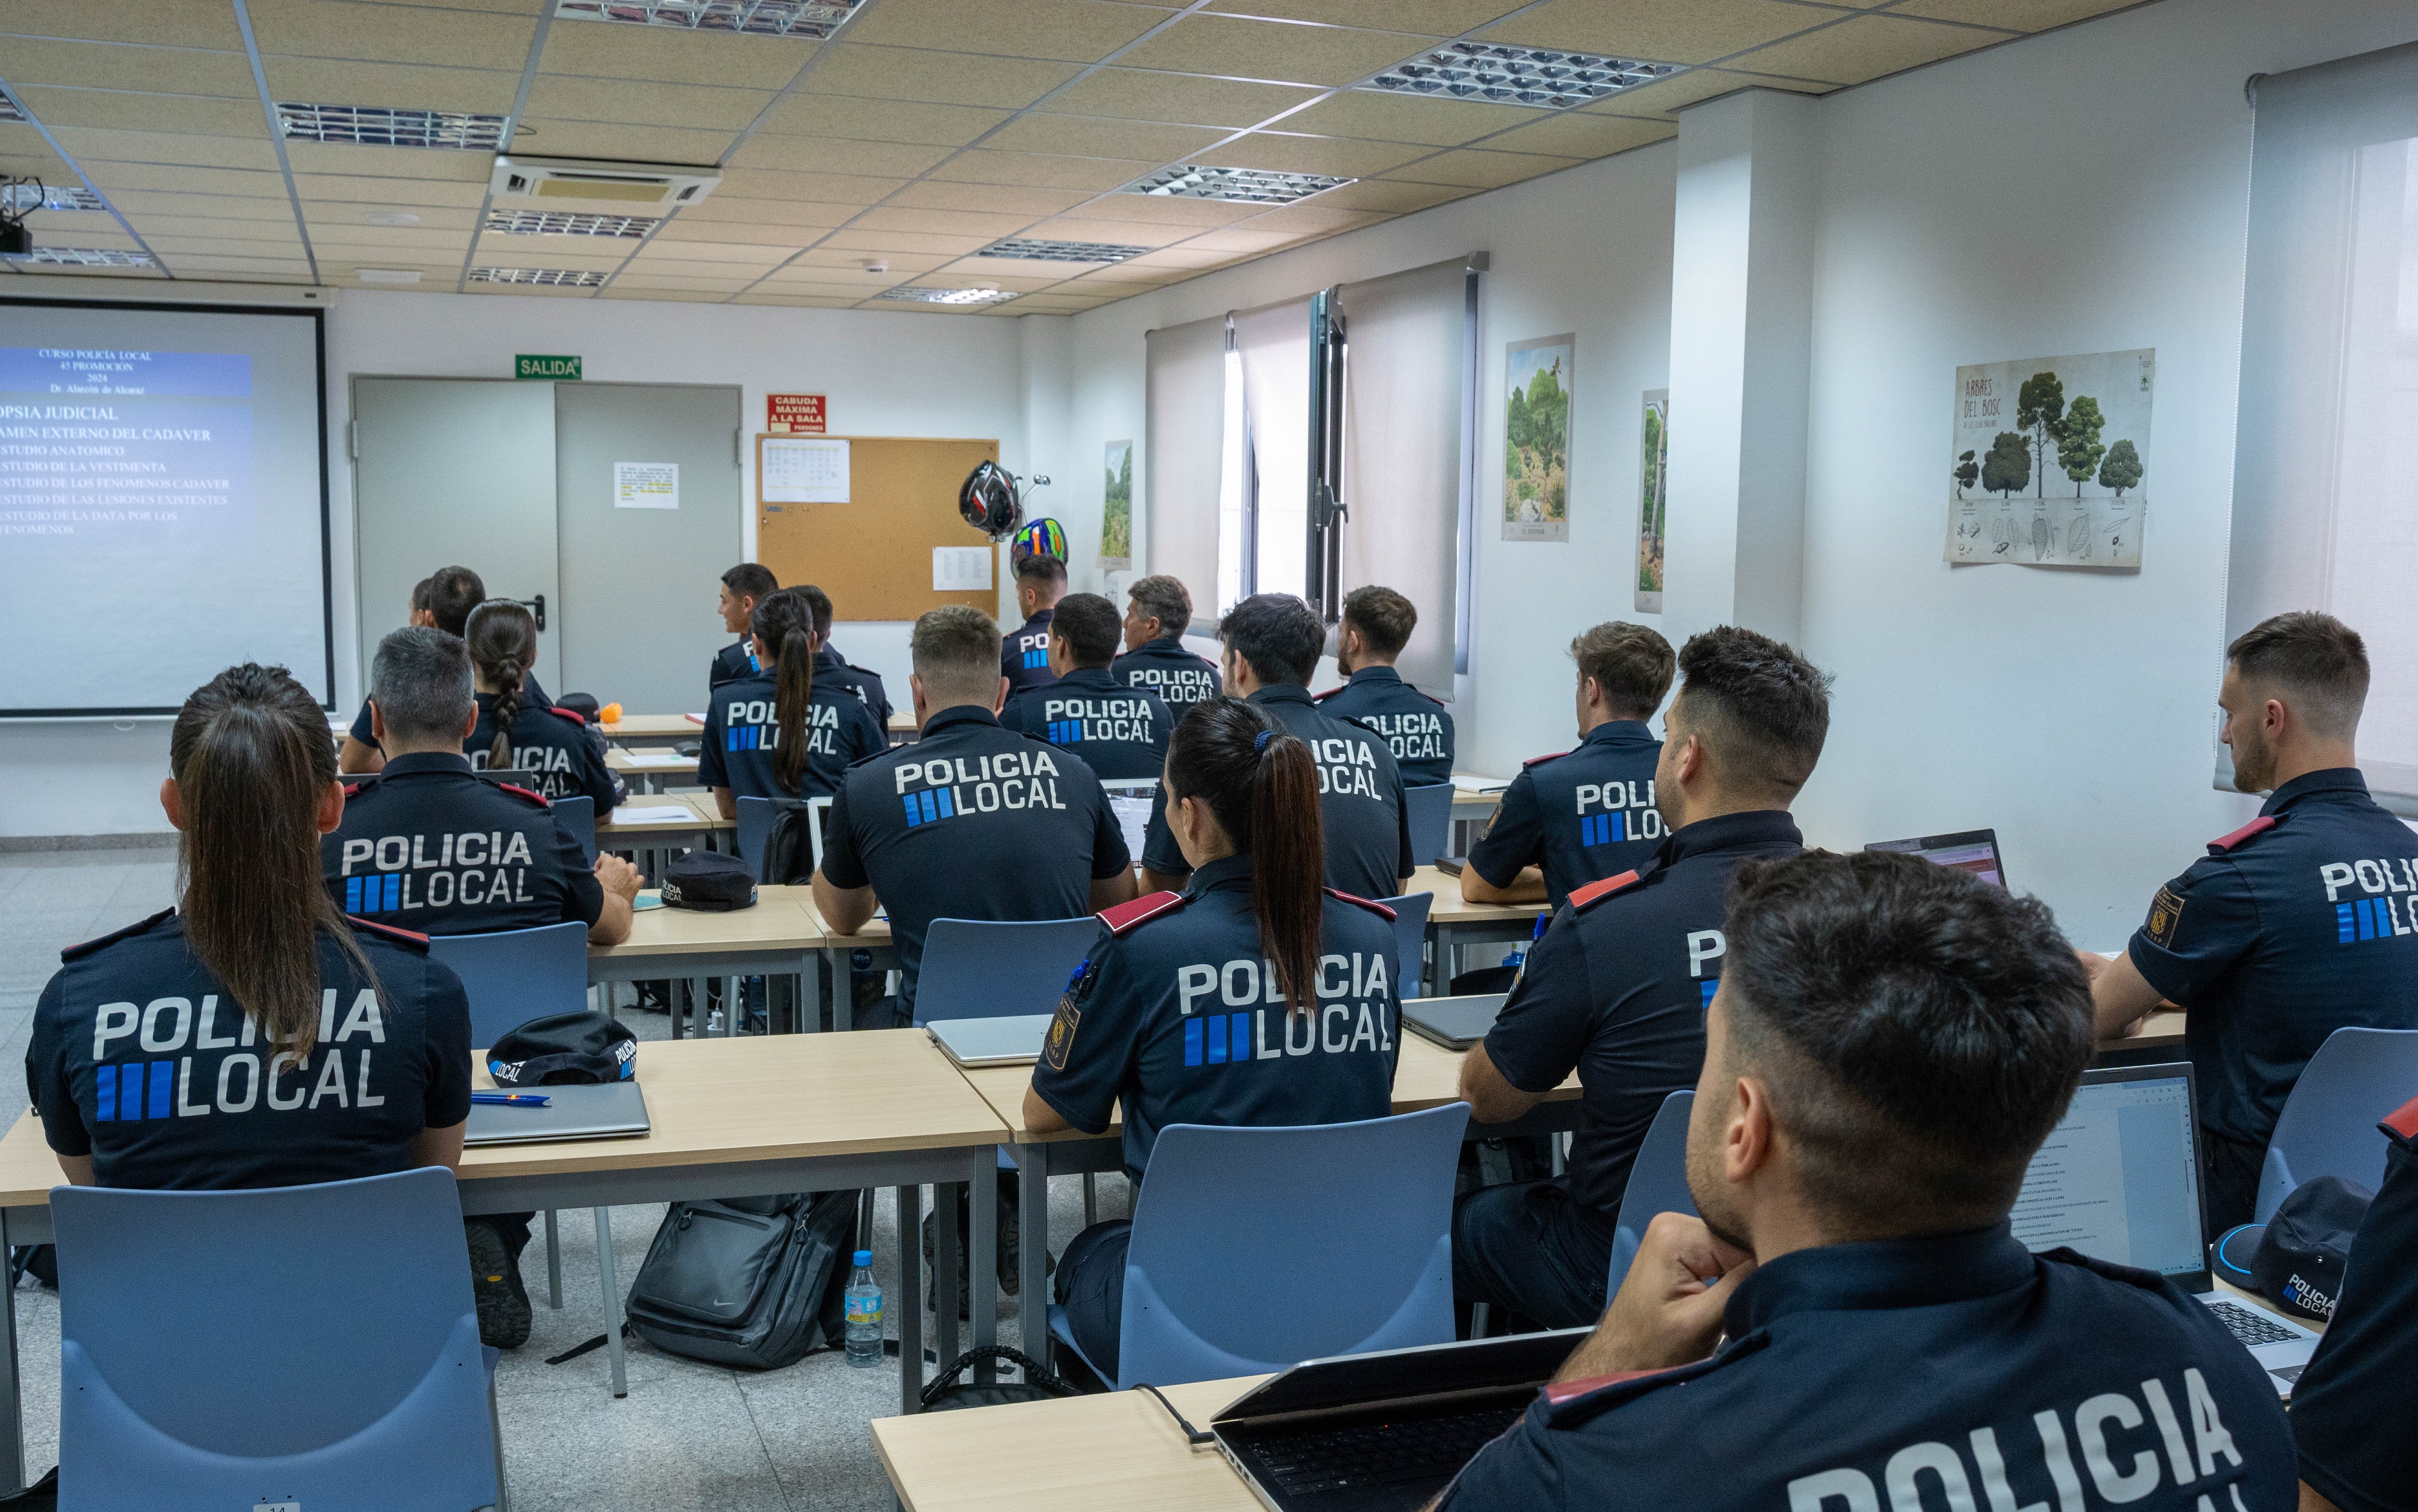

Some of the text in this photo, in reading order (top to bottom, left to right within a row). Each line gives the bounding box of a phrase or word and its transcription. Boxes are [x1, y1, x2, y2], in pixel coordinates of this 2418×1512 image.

[39, 349, 74, 358] CURSO
[119, 351, 152, 361] LOCAL
[87, 374, 108, 382] 2024
[521, 359, 577, 376] SALIDA
[1966, 378, 1992, 398] ARBRES
[775, 396, 818, 405] CABUDA
[1965, 398, 2001, 418] DEL BOSC
[44, 406, 118, 420] JUDICIAL
[42, 426, 108, 440] EXTERNO
[113, 427, 139, 440] DEL
[142, 428, 211, 441] CADAVER
[0, 445, 124, 456] STUDIO ANATOMICO
[0, 461, 166, 473] STUDIO DE LA VESTIMENTA
[51, 478, 66, 488] DE
[70, 479, 94, 489] LOS
[52, 494, 67, 504] DE
[71, 495, 95, 504] LAS
[53, 511, 68, 521] DE
[72, 511, 88, 521] LA
[92, 511, 125, 521] DATA
[128, 511, 151, 521] POR
[154, 511, 178, 521] LOS
[1130, 669, 1214, 688] POLICIA
[728, 700, 838, 729] POLIA
[1046, 700, 1153, 721] POLICIA
[1083, 719, 1154, 743] LOCAL
[1357, 713, 1443, 736] OLICIA
[1390, 735, 1446, 759] OCAL
[895, 751, 1060, 795] POLICIA
[1317, 765, 1382, 801] OCAL
[953, 778, 1066, 816] LOCAL
[1576, 780, 1655, 814] POLI
[341, 831, 533, 876] POLICIA
[403, 869, 534, 909] LOCAL
[1178, 952, 1388, 1015] POLCIA
[1256, 1002, 1392, 1060] LOCAL
[615, 1039, 637, 1065] POLICIA
[495, 1062, 520, 1082] LOCAL
[178, 1049, 385, 1117] LOCAL
[2288, 1274, 2336, 1311] POLICIA
